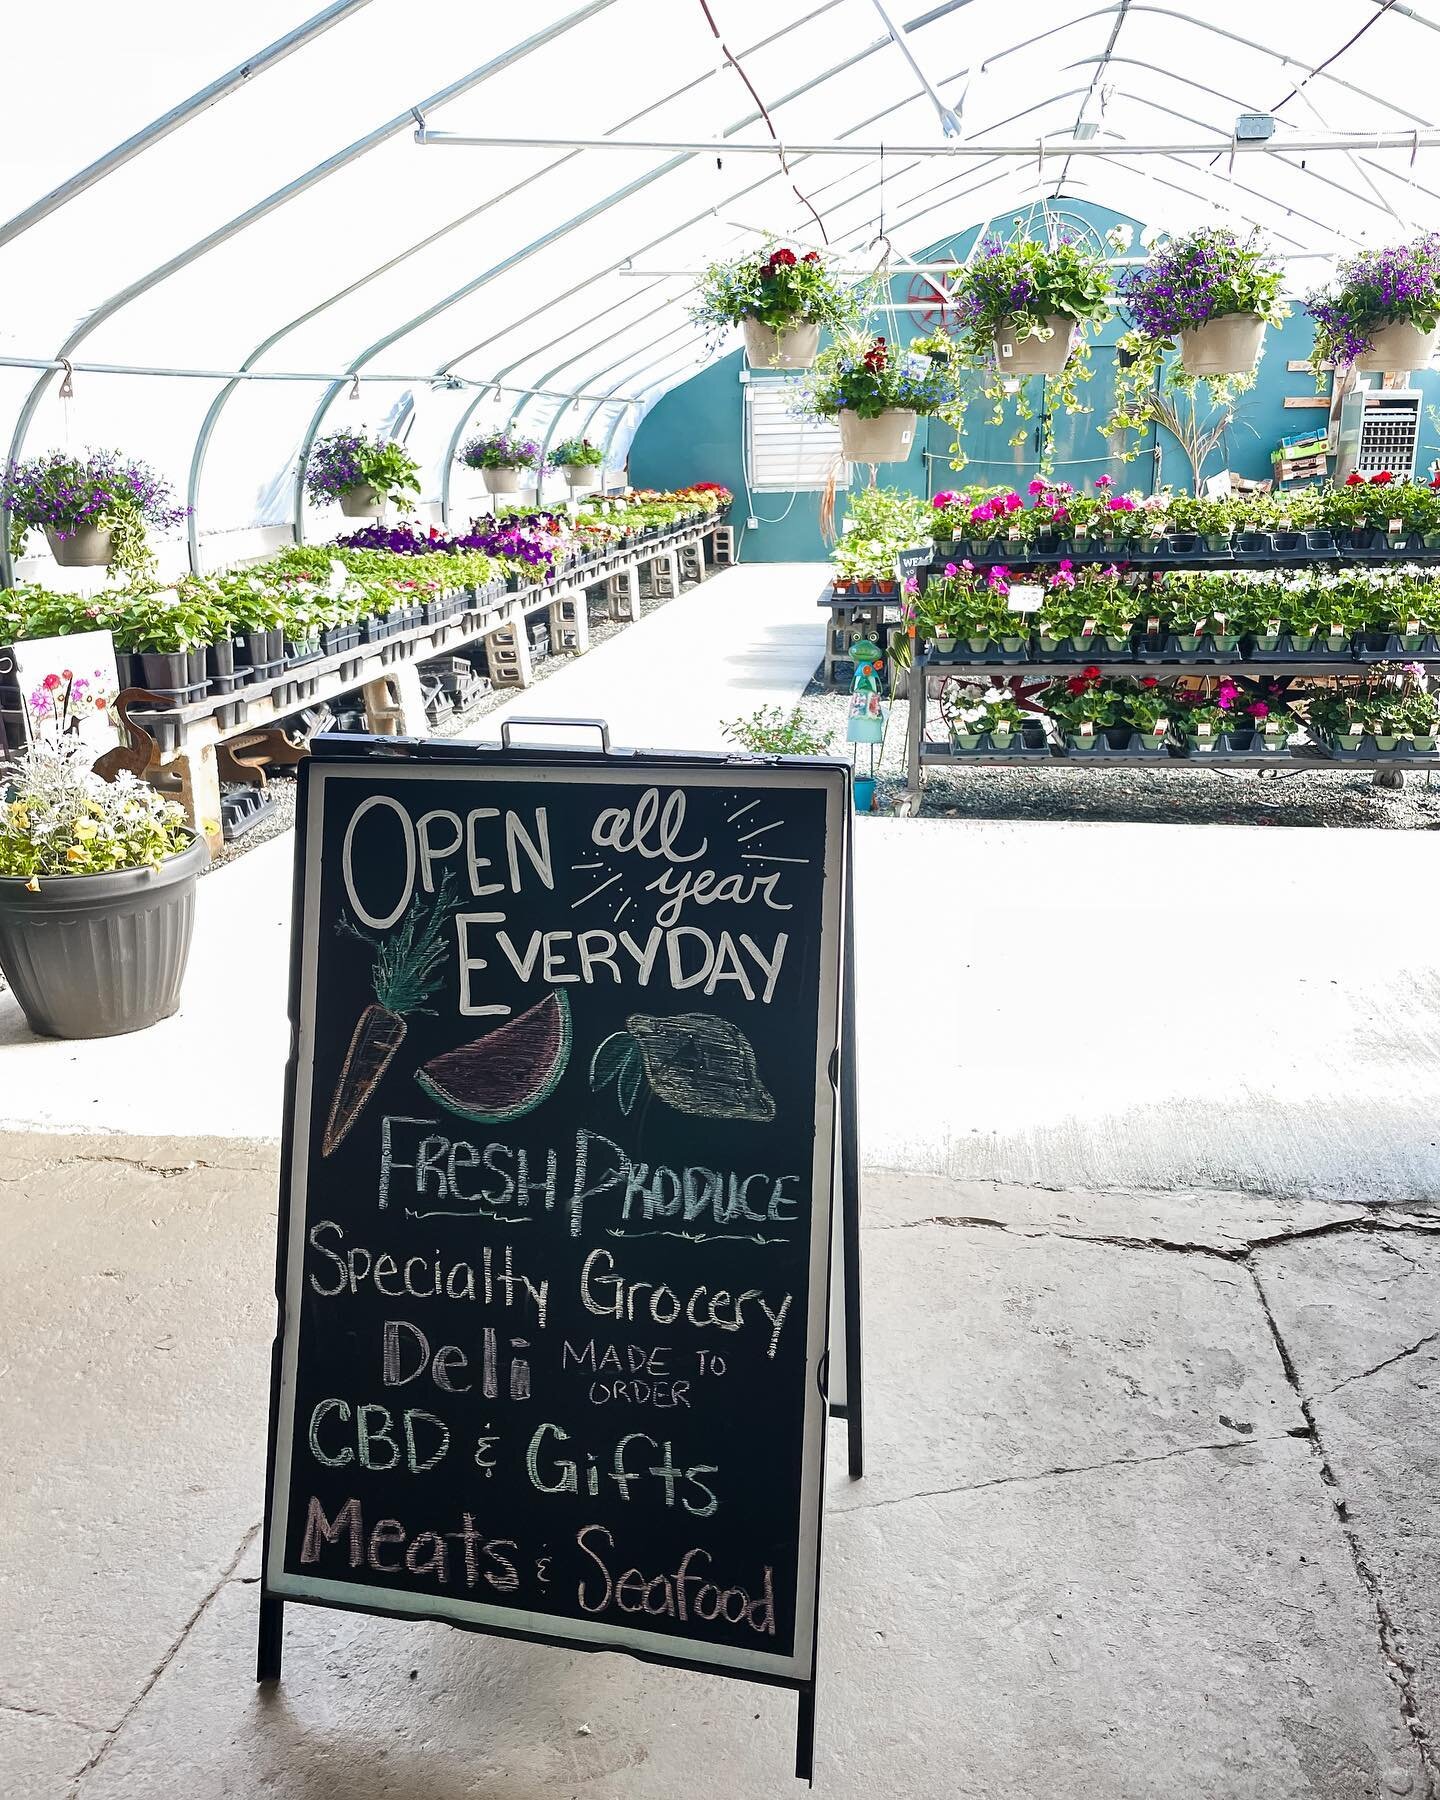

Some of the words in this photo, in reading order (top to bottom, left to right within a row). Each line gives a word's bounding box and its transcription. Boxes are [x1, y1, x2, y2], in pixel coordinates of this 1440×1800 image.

[342, 795, 555, 929] OPEN
[591, 787, 707, 863] all
[645, 866, 793, 927] year
[455, 912, 789, 1016] EVERYDAY
[569, 1128, 799, 1236] PRODUCE
[309, 1220, 548, 1327] Specialty
[581, 1248, 792, 1358] Grocery
[382, 1320, 531, 1400] Deli
[562, 1339, 671, 1377] MADE
[697, 1349, 726, 1376] TO
[588, 1380, 691, 1408] ORDER
[309, 1398, 450, 1473] CBD
[526, 1423, 718, 1517] Gifts
[300, 1495, 519, 1591] Meats
[576, 1524, 776, 1636] Seafood
